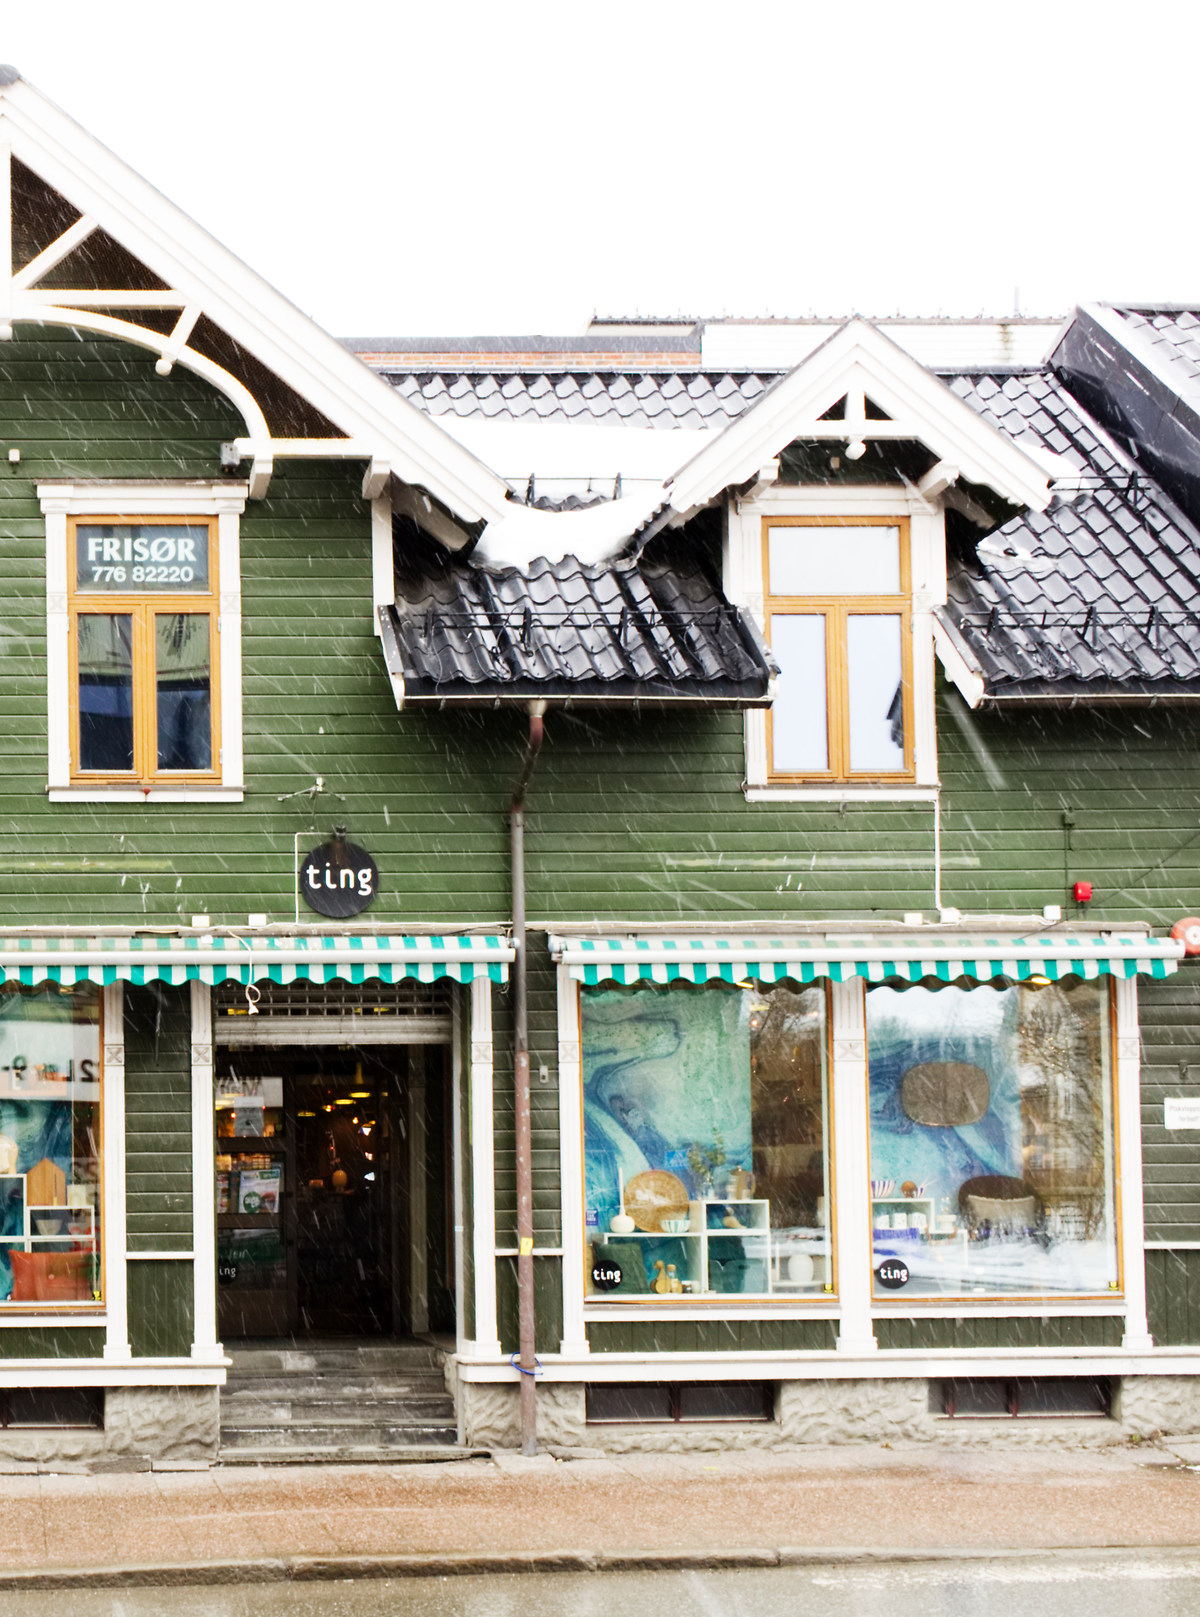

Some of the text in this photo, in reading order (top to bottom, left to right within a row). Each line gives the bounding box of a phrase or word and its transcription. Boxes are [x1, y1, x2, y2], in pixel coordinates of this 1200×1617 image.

[87, 537, 197, 562] FRISØR
[91, 565, 194, 582] 776 82220
[306, 862, 372, 896] ting
[219, 1266, 237, 1278] ing
[593, 1268, 621, 1283] ting
[880, 1267, 908, 1282] ting
